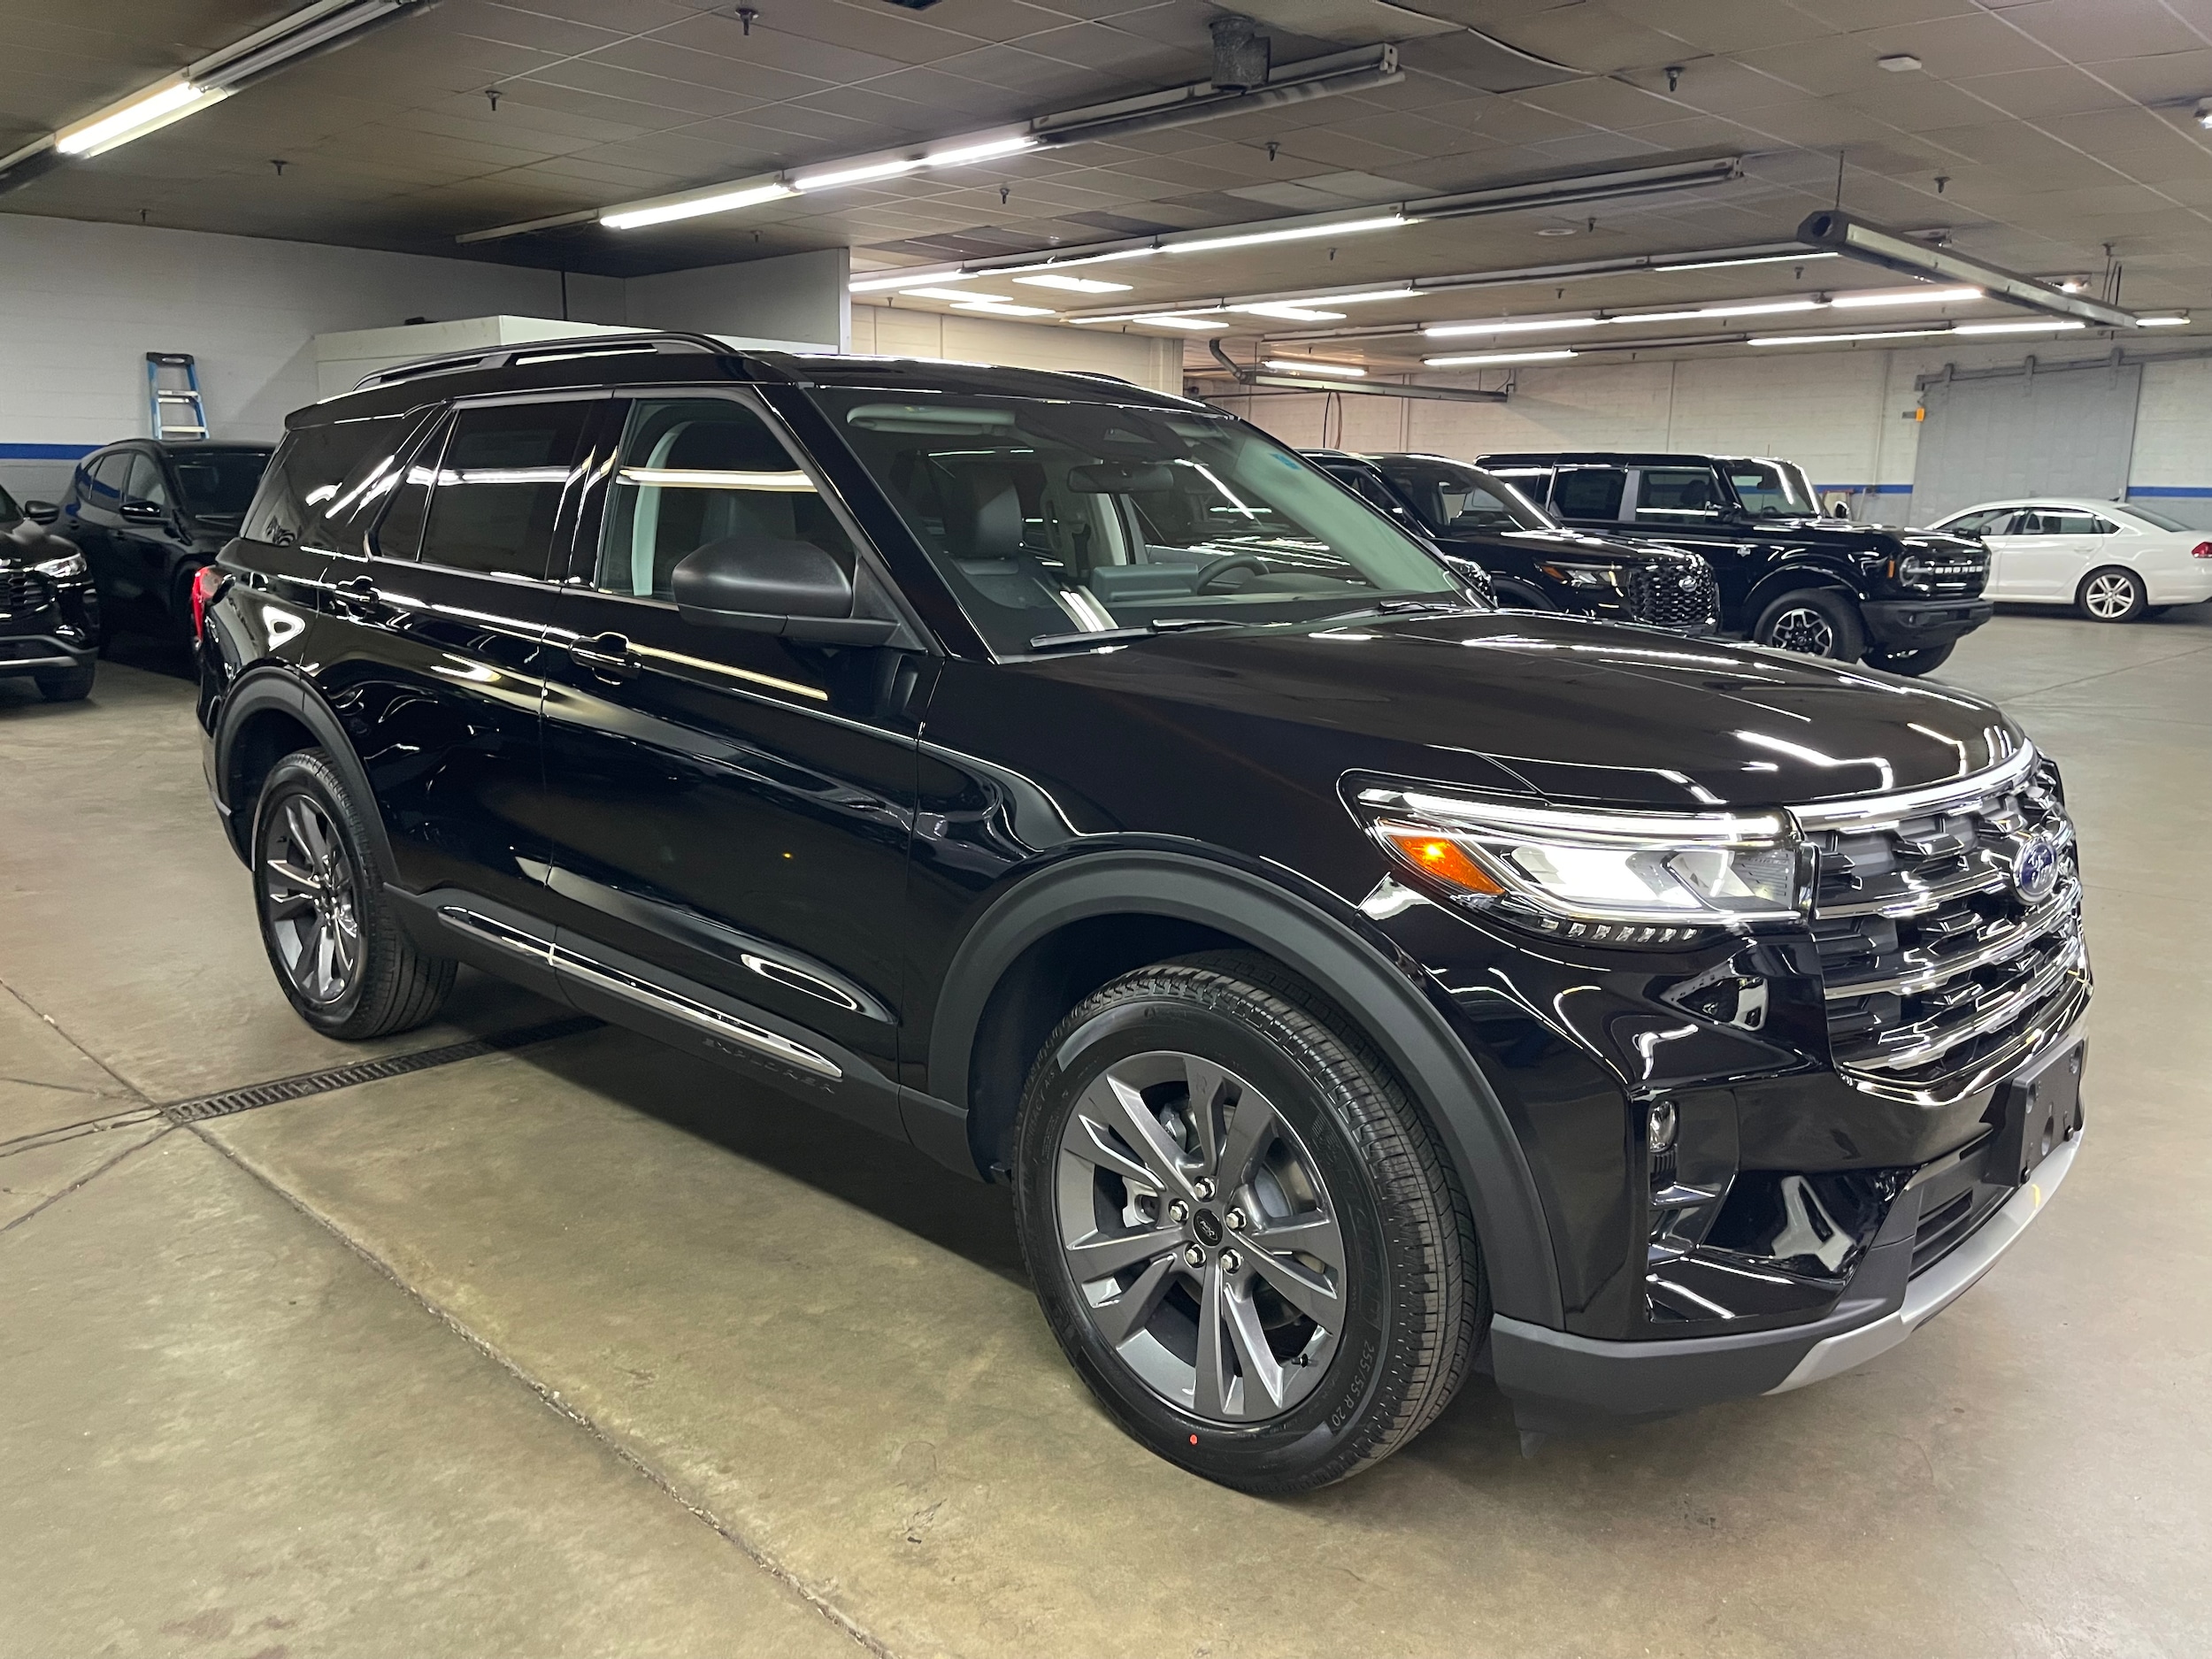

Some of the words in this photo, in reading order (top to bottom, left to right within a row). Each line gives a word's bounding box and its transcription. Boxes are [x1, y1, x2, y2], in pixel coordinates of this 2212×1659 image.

[1935, 565, 1983, 574] BRONCO
[1350, 1340, 1375, 1399] 255/55
[1343, 1394, 1355, 1409] R
[1331, 1405, 1347, 1426] 20
